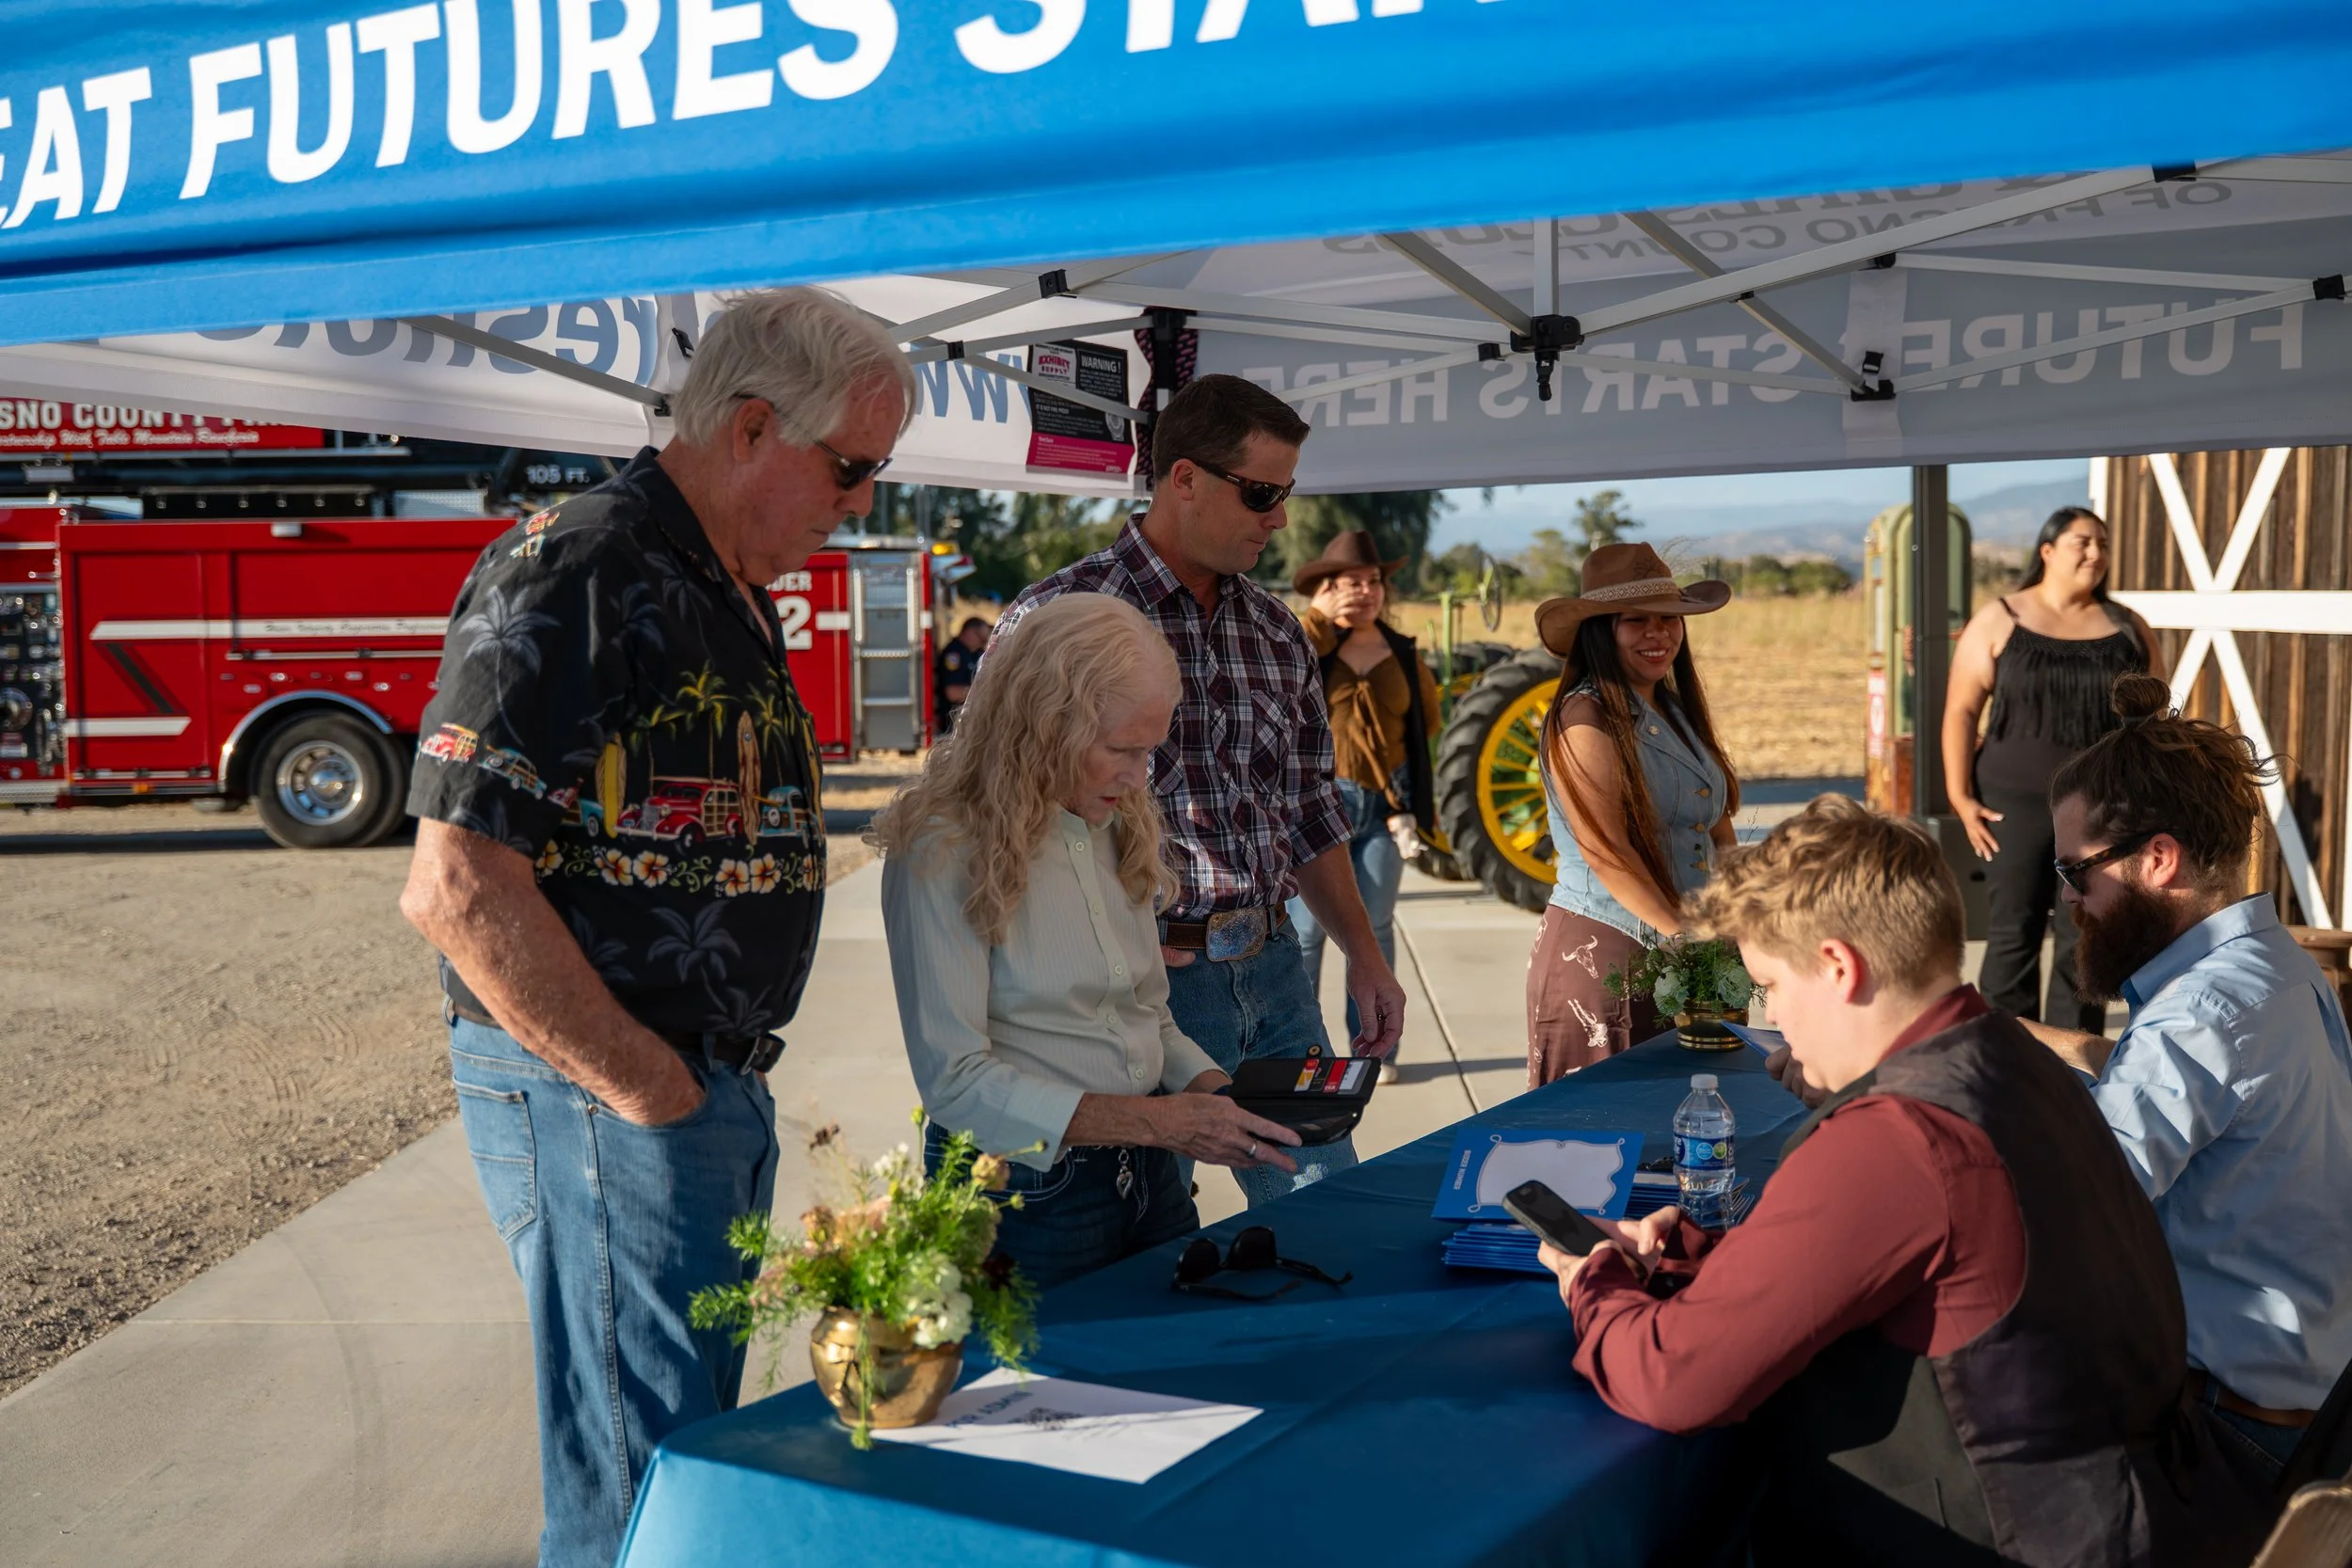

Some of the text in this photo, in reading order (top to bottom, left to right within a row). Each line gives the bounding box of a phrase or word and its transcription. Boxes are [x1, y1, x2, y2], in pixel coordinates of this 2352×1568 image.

[0, 67, 152, 230] AT
[179, 0, 899, 199] FUTURES
[525, 464, 562, 484] 105
[766, 570, 813, 592] DER
